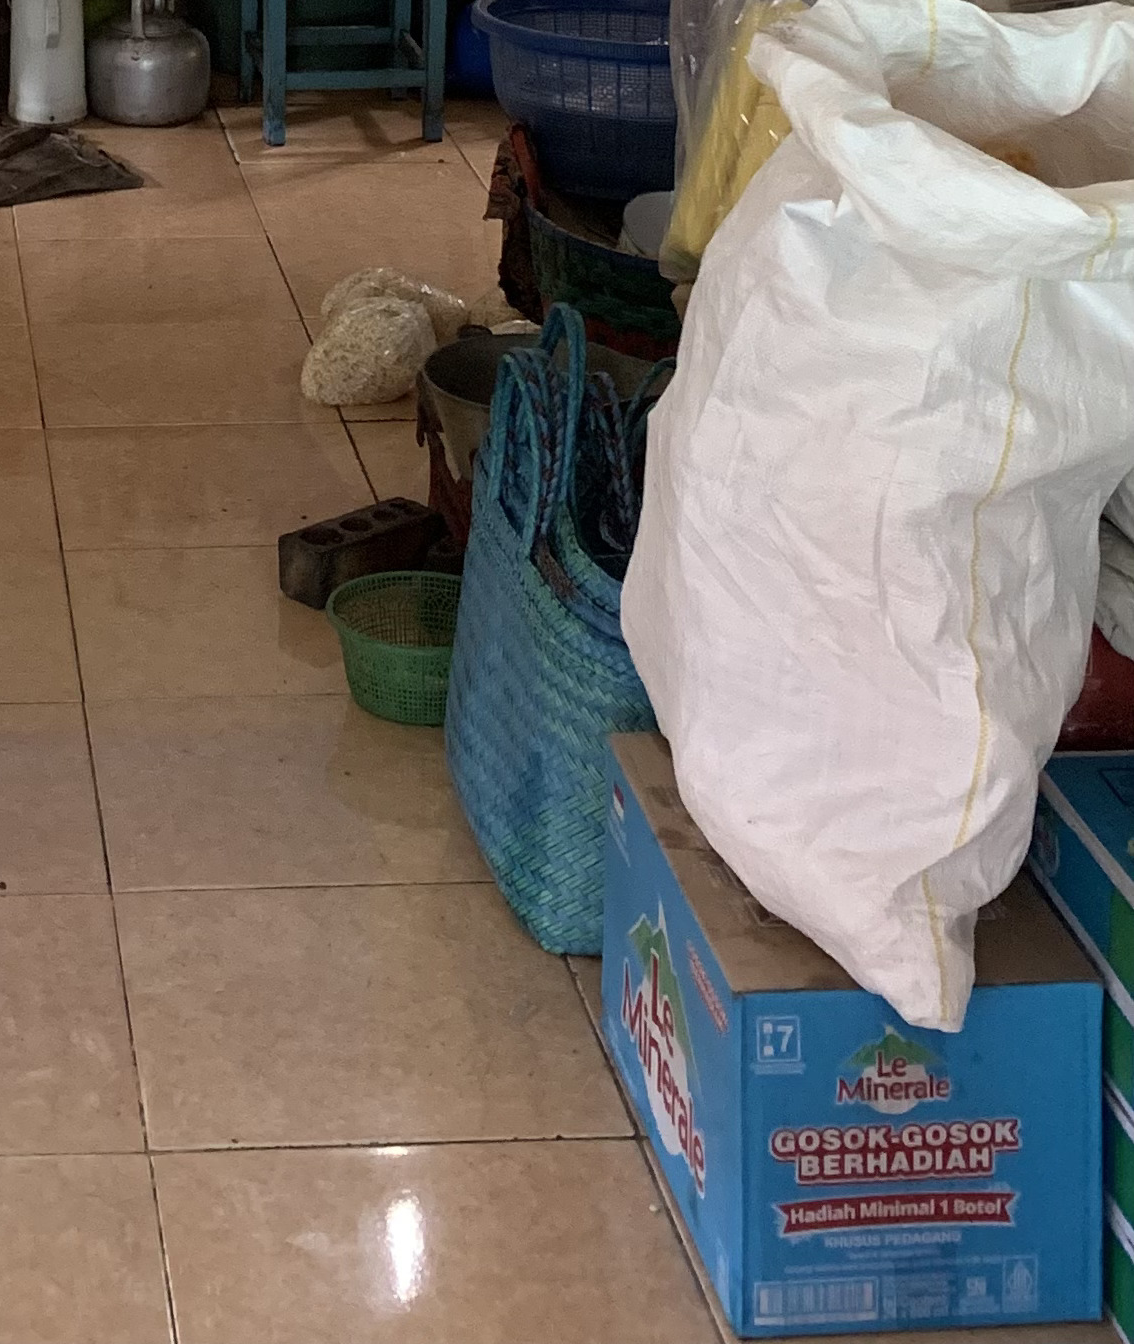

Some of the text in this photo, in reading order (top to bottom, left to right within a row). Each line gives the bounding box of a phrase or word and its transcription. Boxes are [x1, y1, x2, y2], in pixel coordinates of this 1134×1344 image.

[649, 948, 674, 1059] Le
[622, 958, 705, 1199] Minerale
[876, 1051, 908, 1078] Le
[836, 1072, 951, 1104] Minerale
[773, 1118, 1016, 1155] GOSOK-GOSOK
[799, 1146, 991, 1178] BERHADIAH
[790, 1204, 856, 1224] Hadiah
[860, 1198, 935, 1218] Minimal
[939, 1199, 949, 1215] 1
